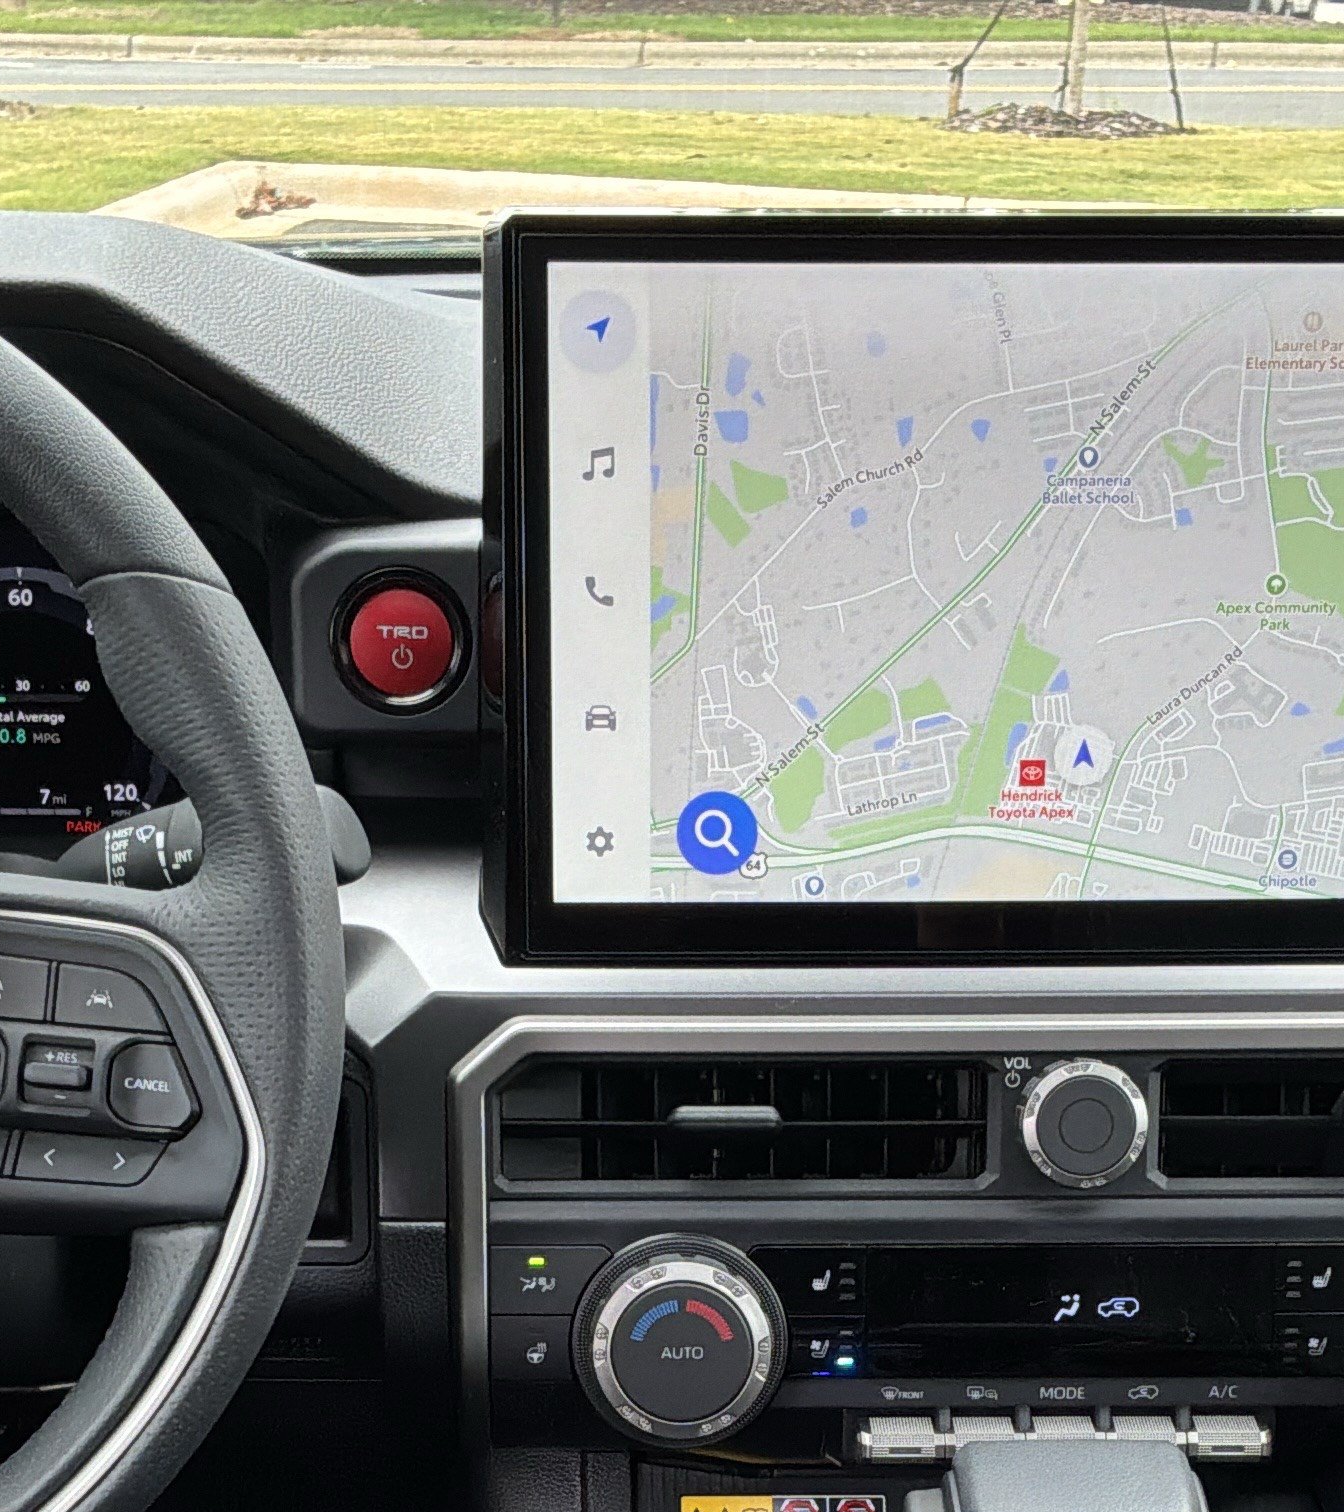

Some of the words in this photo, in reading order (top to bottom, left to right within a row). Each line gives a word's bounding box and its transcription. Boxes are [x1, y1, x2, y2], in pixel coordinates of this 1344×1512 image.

[1274, 340, 1317, 352] Laurel
[1246, 357, 1326, 372] Elementary
[697, 386, 710, 407] Dr
[1090, 418, 1106, 436] N
[1103, 377, 1140, 423] Salem
[1137, 358, 1155, 380] St
[694, 409, 710, 457] Davis
[815, 477, 855, 510] Salem
[855, 460, 904, 485] Church
[903, 448, 925, 471] Rd
[1046, 475, 1132, 491] Campaneria
[1042, 492, 1079, 505] Ballet
[1083, 492, 1135, 505] School
[8, 589, 33, 606] 60
[1216, 601, 1250, 617] Apex
[1255, 601, 1336, 617] Community
[1260, 619, 1290, 631] Park
[376, 625, 429, 640] TRD
[16, 680, 30, 691] 30
[75, 680, 90, 692] 60
[1147, 695, 1181, 725] Laura
[1180, 661, 1227, 700] Duncan
[1223, 645, 1244, 667] Rd
[16, 711, 65, 727] Average
[33, 733, 60, 744] MPG
[755, 770, 772, 789] N
[769, 739, 808, 777] Salem
[807, 722, 825, 742] St
[39, 788, 51, 805] 7
[52, 794, 67, 805] mi
[104, 784, 137, 801] 120
[1001, 789, 1062, 802] Hendrick
[847, 794, 899, 816] Lathrop
[902, 791, 918, 804] Ln
[86, 806, 93, 817] F
[989, 806, 1034, 821] Toyota
[1036, 806, 1074, 822] Apex
[66, 821, 102, 833] PARK
[112, 826, 135, 839] MIST
[111, 839, 129, 851] OFF
[111, 852, 127, 863] INT
[174, 849, 193, 863] INT
[112, 866, 125, 877] LO
[746, 860, 761, 871] 64
[1258, 875, 1316, 890] Chipotle
[1004, 1057, 1032, 1069] VOL
[124, 1077, 170, 1093] CANCEL
[661, 1346, 704, 1360] AUTO
[898, 1391, 924, 1399] FRONT
[1039, 1386, 1085, 1400] MODE
[1208, 1385, 1238, 1399] A/C
